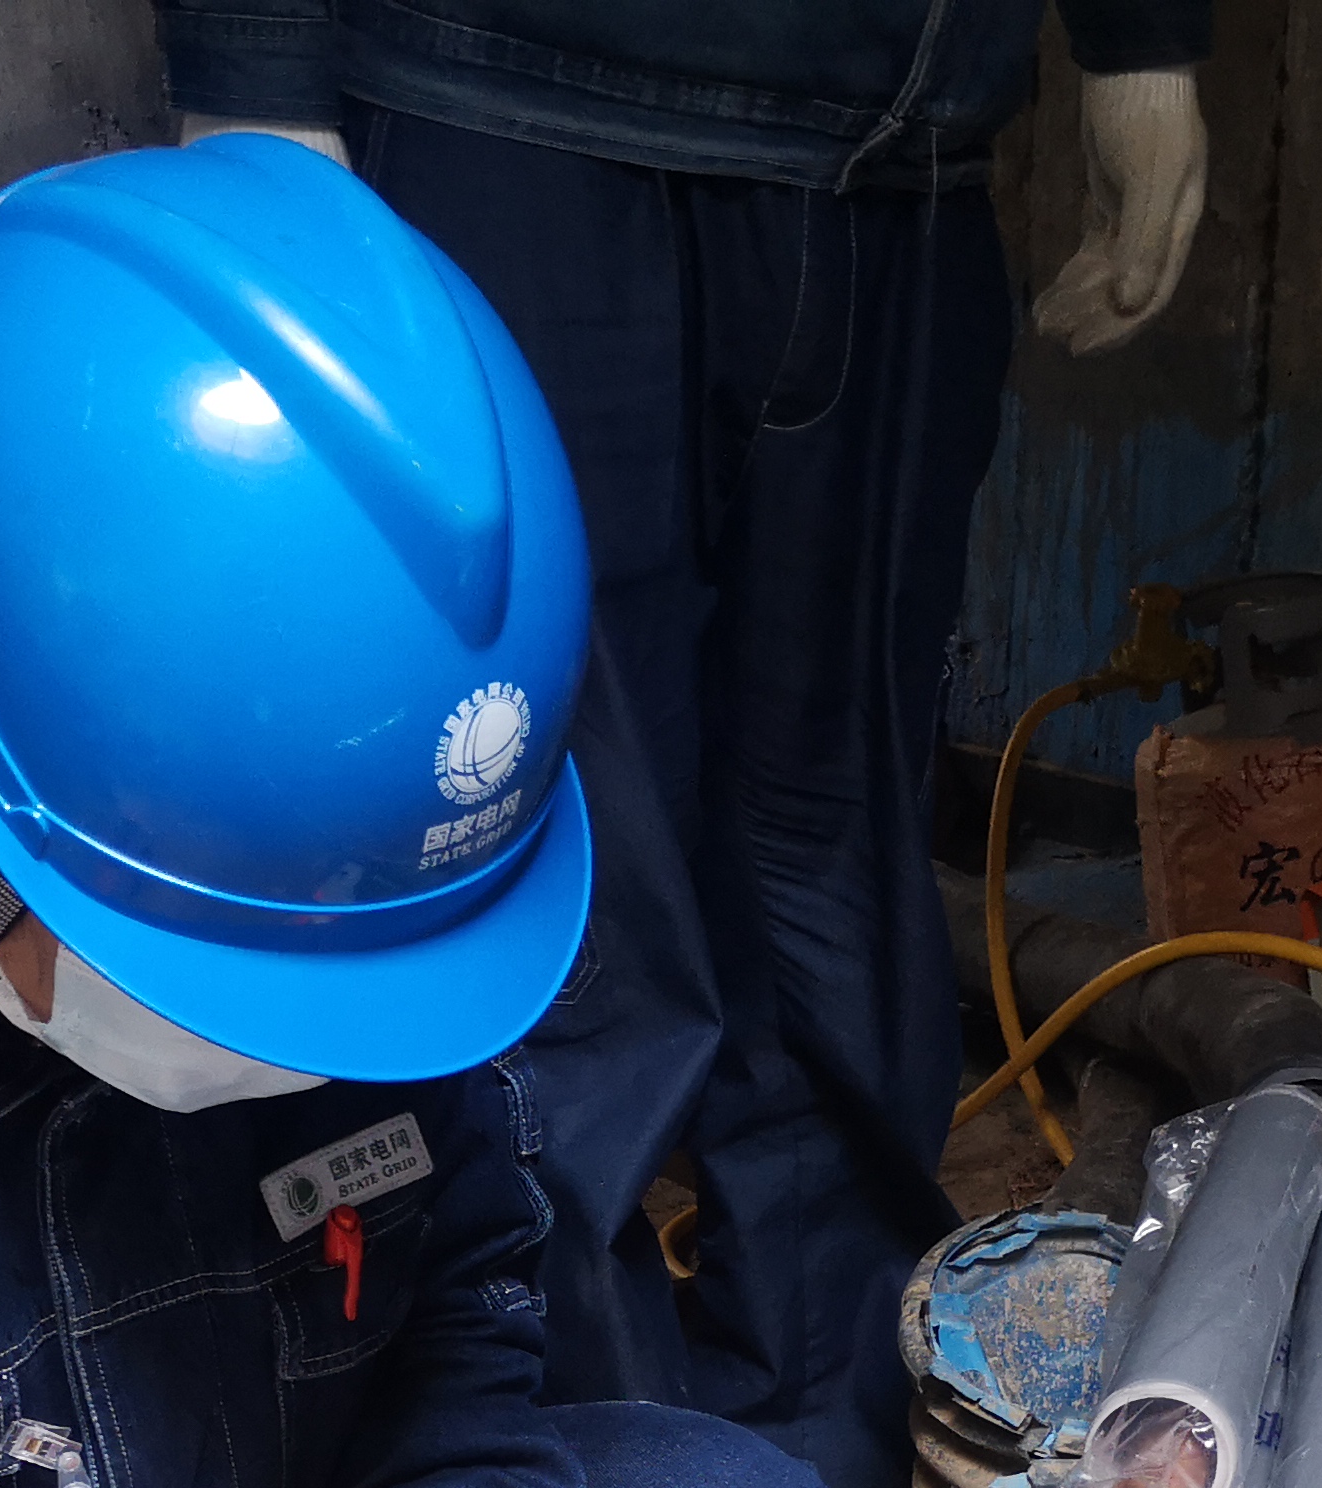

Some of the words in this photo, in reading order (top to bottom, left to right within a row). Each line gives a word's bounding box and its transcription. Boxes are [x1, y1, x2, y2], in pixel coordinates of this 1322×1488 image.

[443, 681, 526, 733] 国家电网公司
[435, 735, 451, 776] STATE
[437, 776, 456, 800] GRID
[453, 761, 518, 806] CORPORATION
[418, 842, 472, 871] STATE
[476, 820, 513, 850] GRID
[422, 788, 523, 855] 国家电网
[1239, 841, 1300, 912] 宏
[328, 1128, 412, 1181] 国家电网
